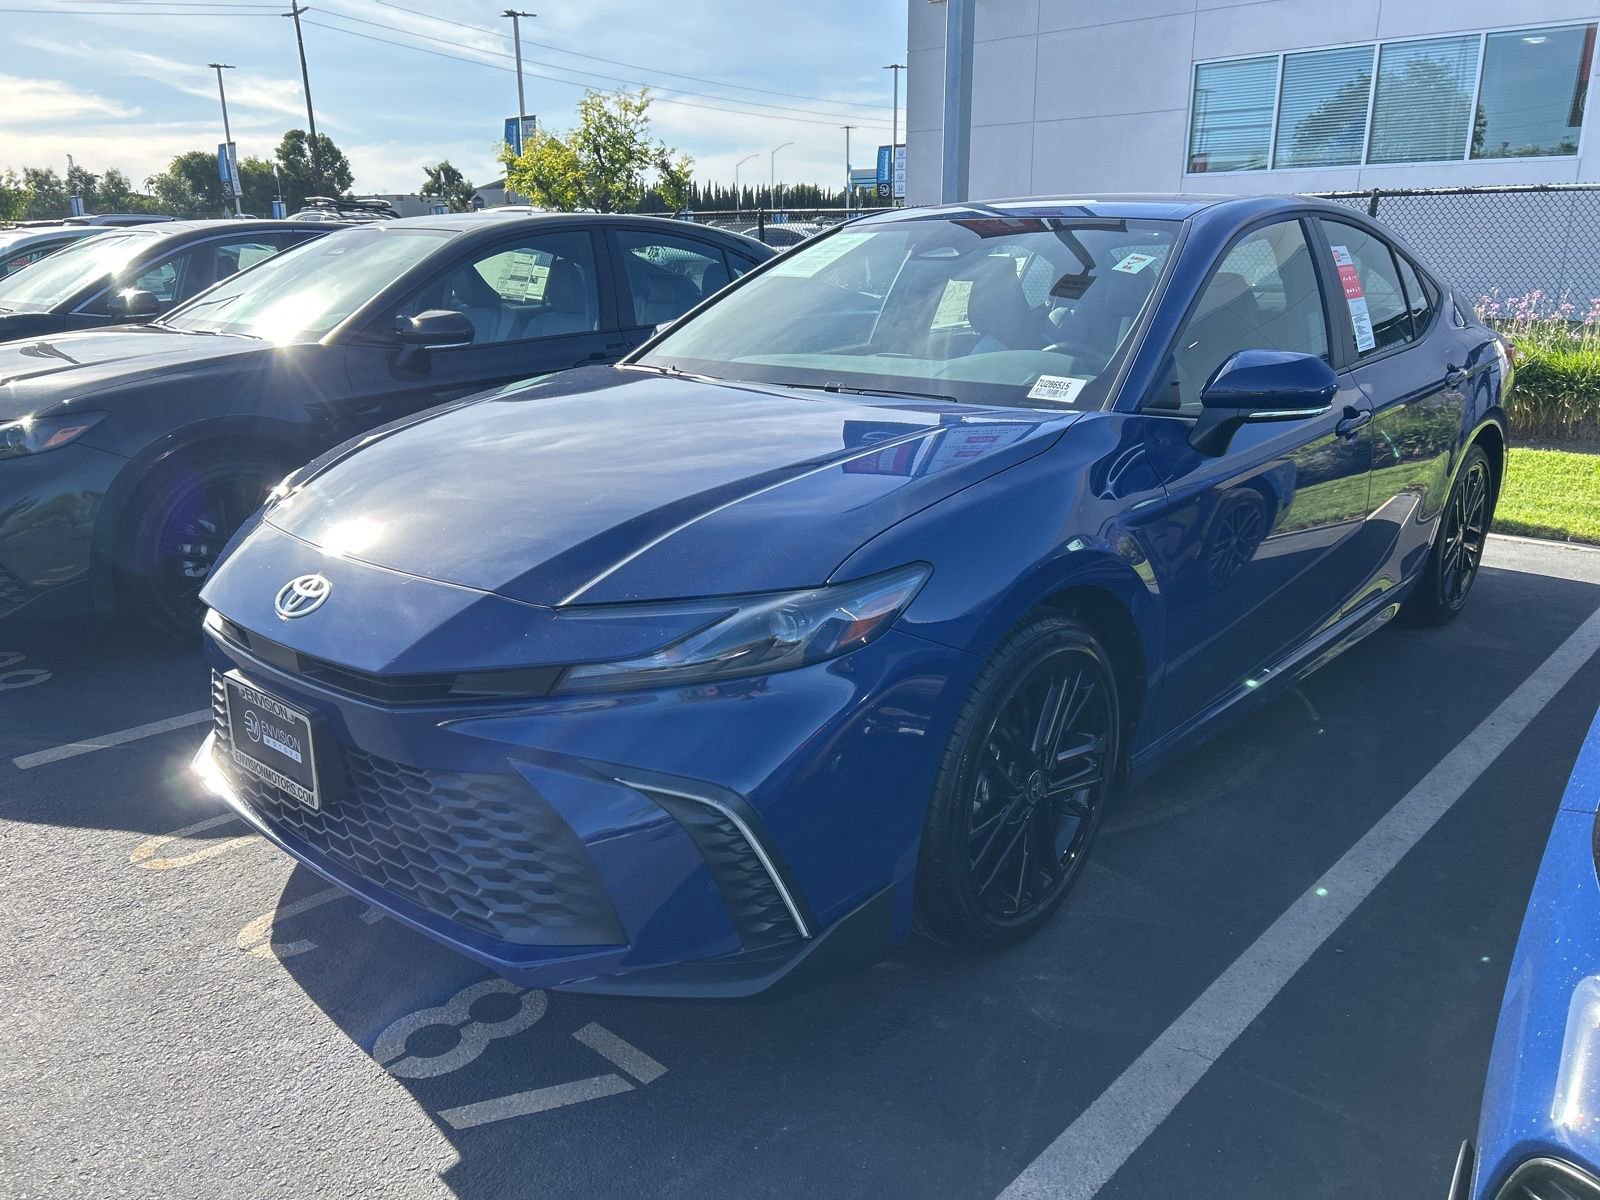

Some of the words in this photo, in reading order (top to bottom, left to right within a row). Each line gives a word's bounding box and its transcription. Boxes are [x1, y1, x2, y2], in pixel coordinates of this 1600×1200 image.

[1036, 379, 1072, 391] TU286515
[244, 688, 288, 719] ENVISION
[261, 720, 301, 753] ENVISION
[235, 752, 315, 806] ENVISIONMOTORS.COM
